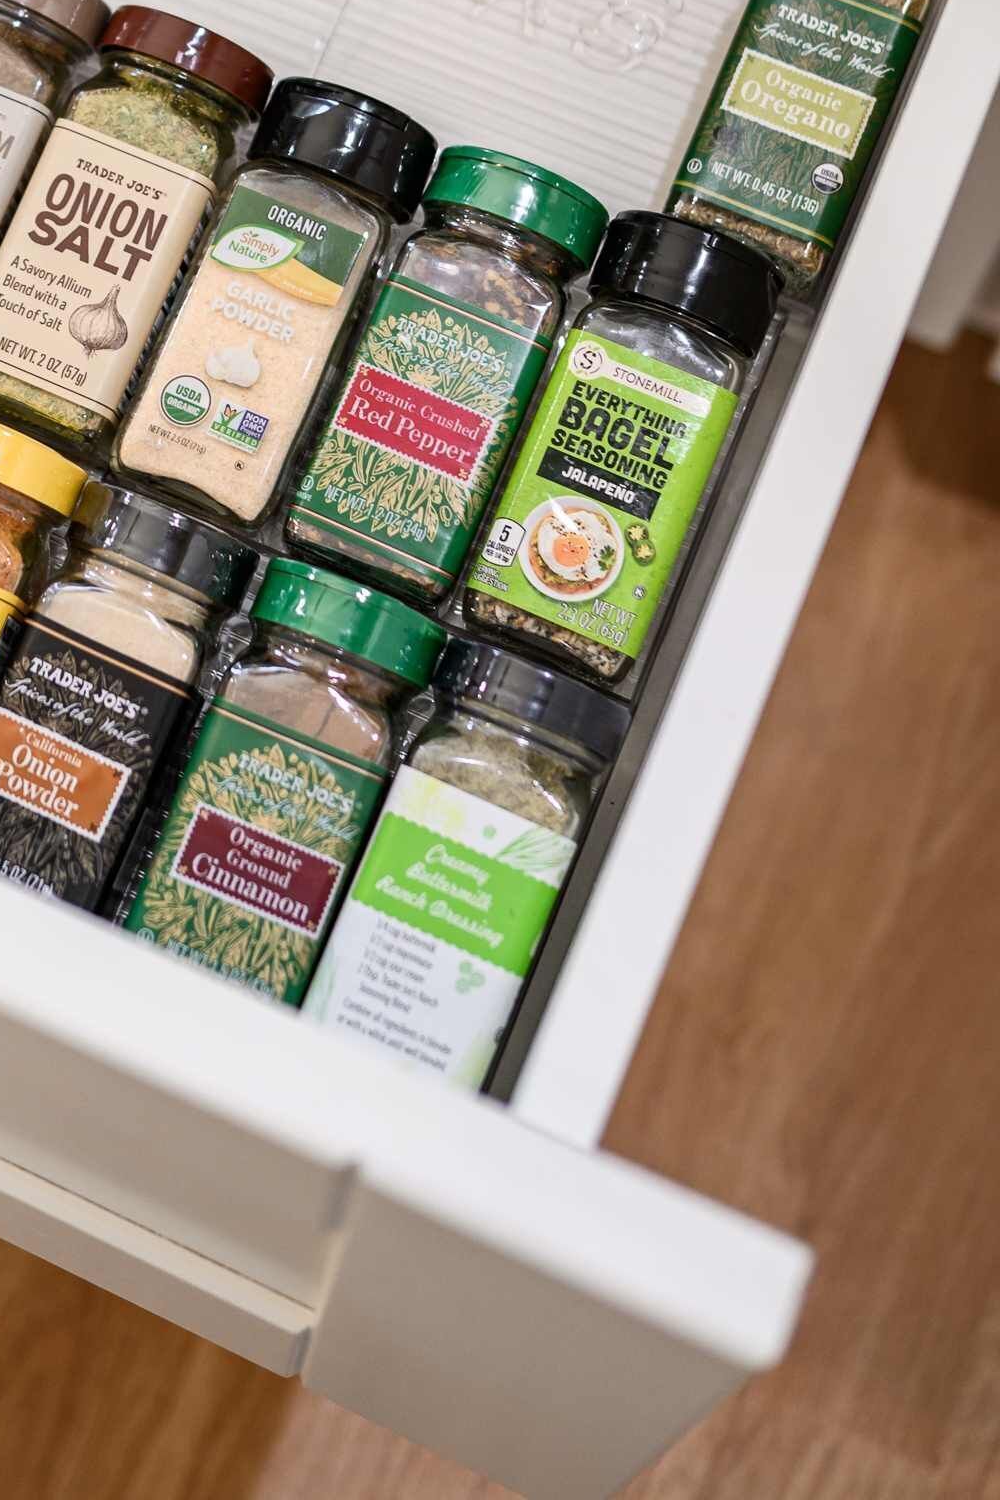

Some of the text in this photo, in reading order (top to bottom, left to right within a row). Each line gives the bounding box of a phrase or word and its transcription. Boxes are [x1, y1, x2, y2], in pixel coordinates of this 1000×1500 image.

[777, 4, 884, 54] TRADER JOE'S
[740, 80, 850, 140] Oregano
[766, 69, 841, 110] Organic
[76, 158, 162, 200] TRADER JOE'S
[46, 174, 168, 250] ONION
[267, 204, 328, 241] ORGANIC
[28, 210, 152, 281] SALT
[229, 240, 267, 262] Nature
[240, 231, 280, 257] Simply
[2, 274, 67, 310] Blend with a
[10, 255, 92, 298] A Savory Allium
[26, 306, 40, 321] of
[40, 310, 64, 332] Salt
[209, 296, 296, 342] POWDER
[226, 279, 296, 321] GARLIC
[396, 316, 503, 373] TRADER JOE'S
[175, 383, 202, 405] USDA
[358, 378, 481, 443] Organic Crushed
[572, 381, 688, 439] EVERYTHING
[211, 421, 260, 447] VERIFIED
[349, 395, 471, 465] Red Pepper
[558, 397, 675, 471] BAGEL
[550, 429, 668, 490] SEASONING
[561, 466, 636, 505] JALAPEÑO
[30, 657, 140, 719] TRADER JOE'S
[12, 743, 79, 794] Onion
[26, 731, 82, 768] California
[237, 753, 354, 814] TRADER JOE'S
[226, 849, 292, 890] Ground
[229, 826, 303, 871] Organic
[425, 843, 489, 885] Creamy
[191, 853, 309, 922] Cinnamon
[406, 862, 492, 912] Buttermilk
[375, 874, 428, 912] Ranch
[428, 899, 504, 948] Dressing
